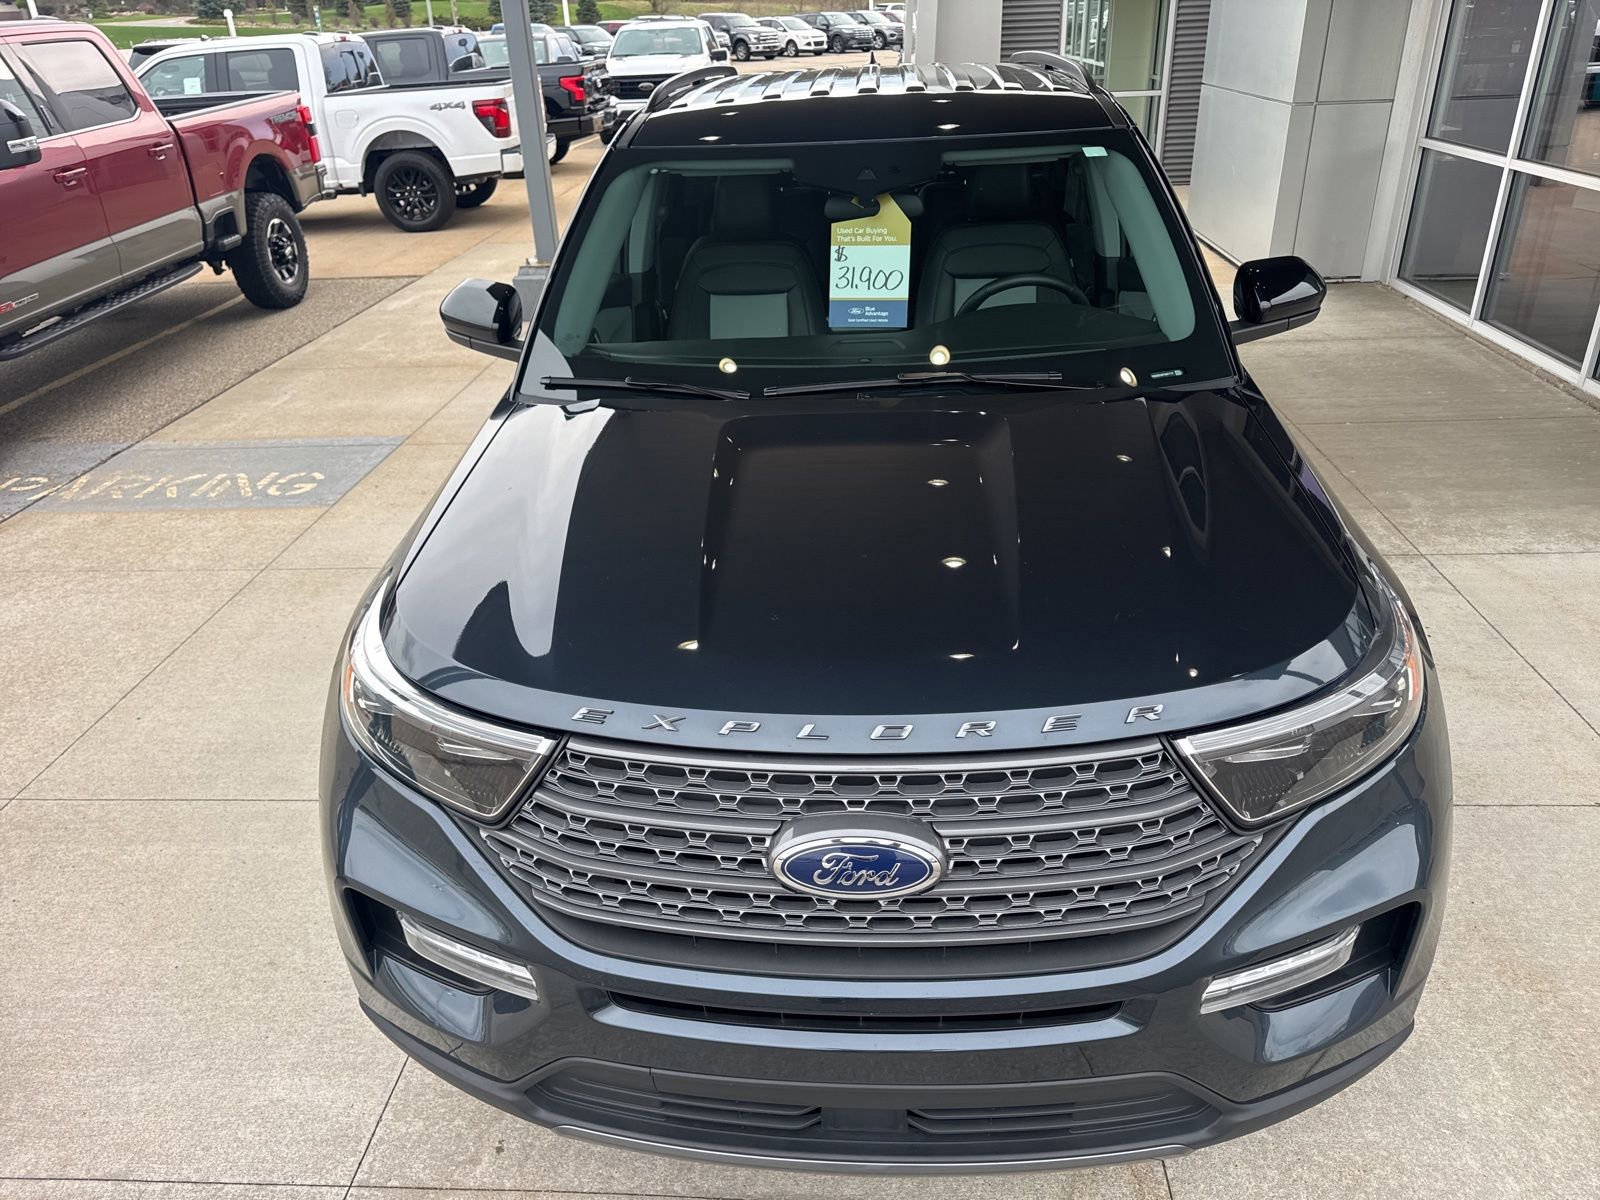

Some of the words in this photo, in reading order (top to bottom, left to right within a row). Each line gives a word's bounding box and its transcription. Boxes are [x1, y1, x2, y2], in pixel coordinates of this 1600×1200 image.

[866, 227, 888, 235] Buying
[834, 245, 848, 262] $
[571, 703, 1164, 741] EXPLORER
[812, 852, 901, 886] Ford
